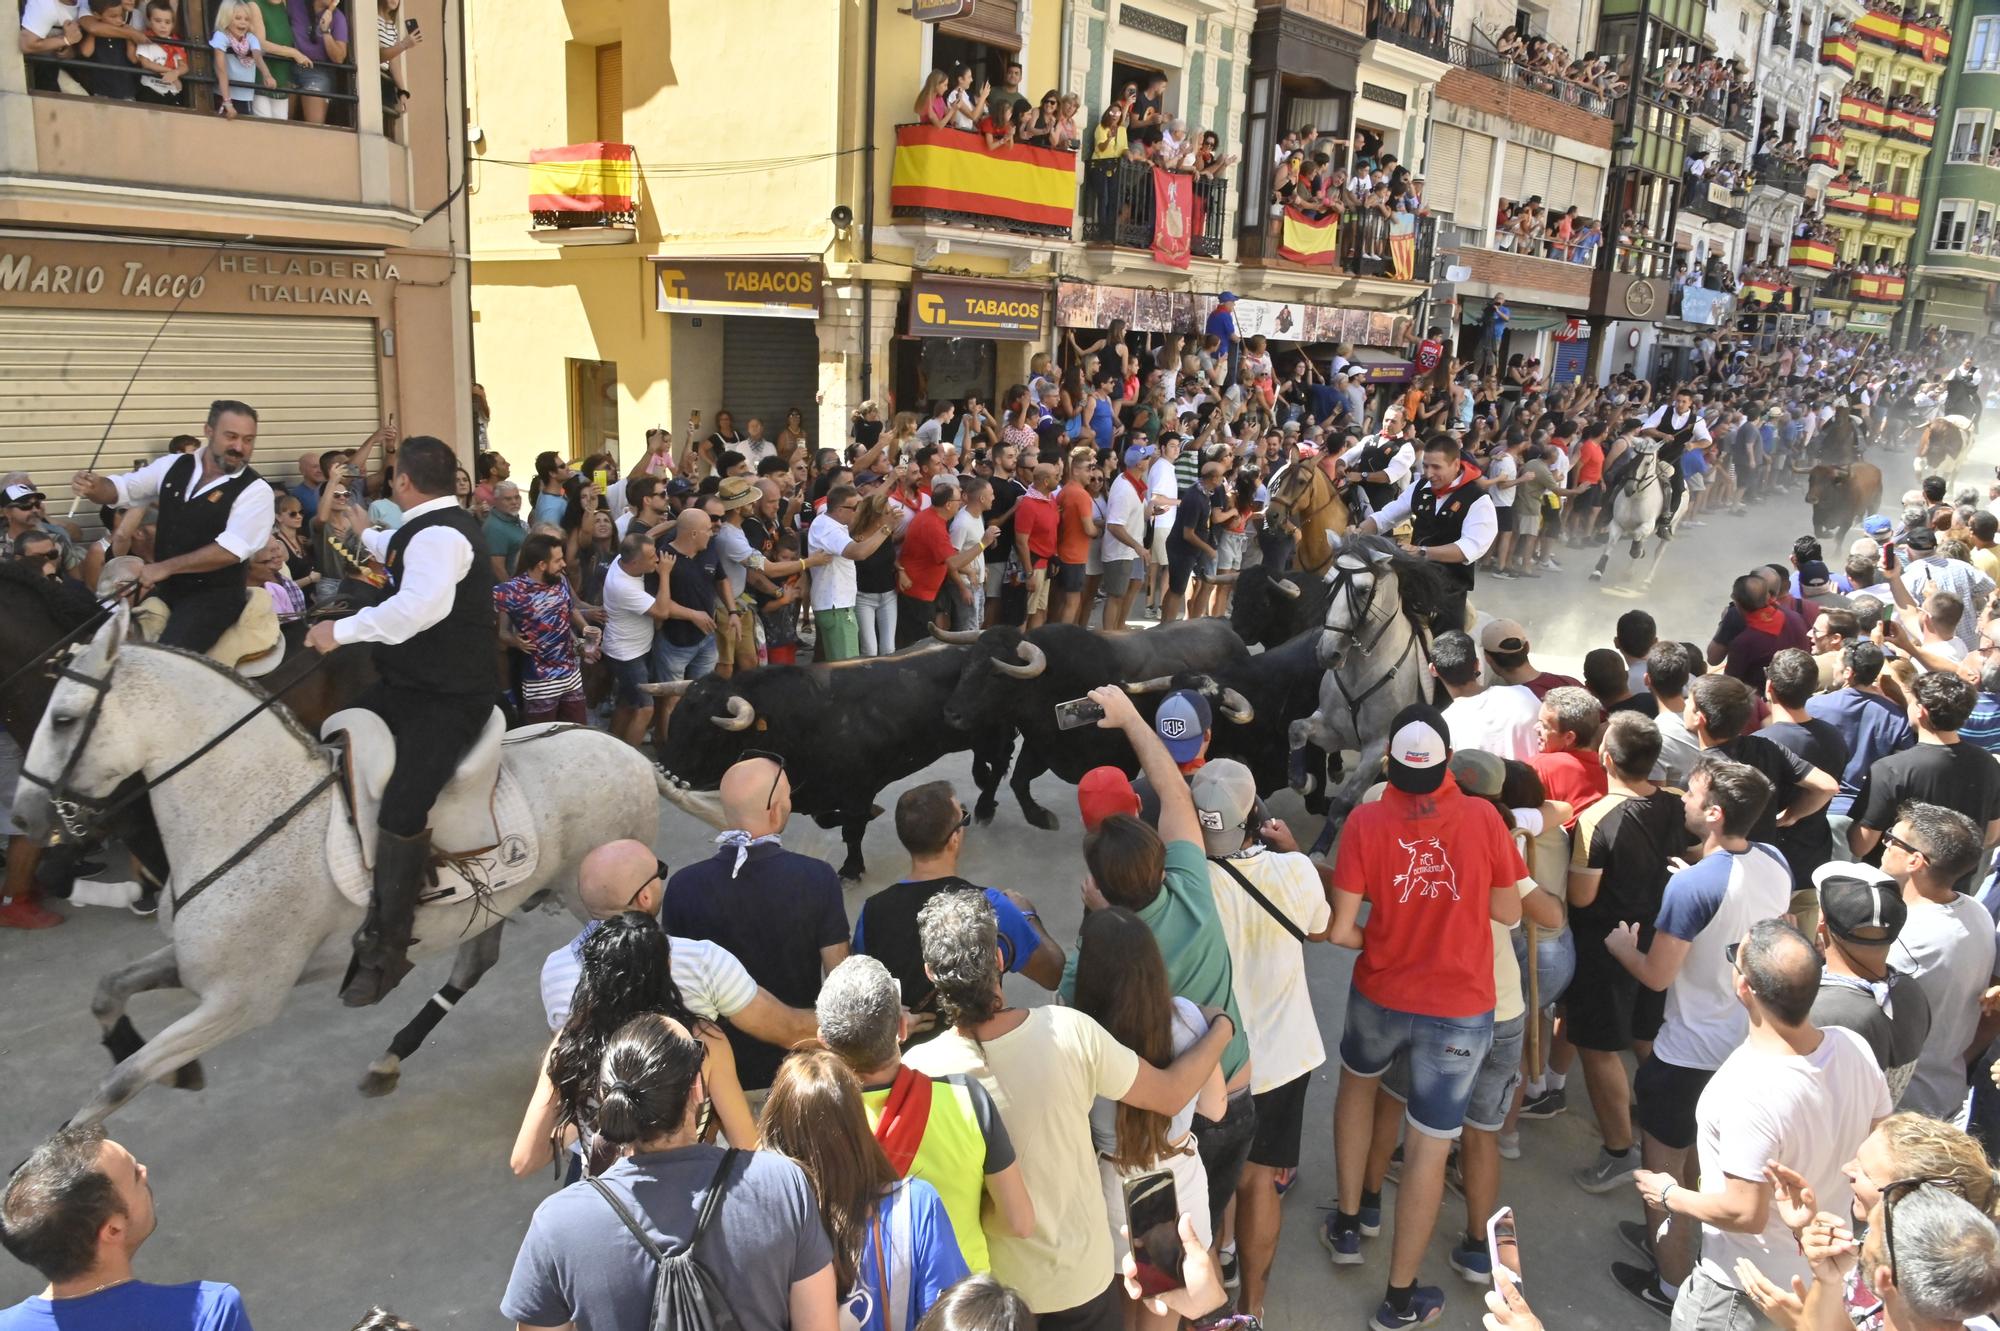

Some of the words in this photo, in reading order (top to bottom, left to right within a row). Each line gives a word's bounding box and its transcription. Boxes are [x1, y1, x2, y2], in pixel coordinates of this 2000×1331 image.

[0, 253, 105, 295] MARIO
[121, 261, 206, 299] TACCO
[219, 255, 401, 280] HELADERIA
[724, 271, 813, 293] TABACOS
[250, 284, 372, 305] ITALIANA
[965, 298, 1040, 319] TABACOS
[1420, 352, 1437, 368] 23
[1163, 720, 1184, 735] DEUS
[1445, 1044, 1470, 1057] FILA
